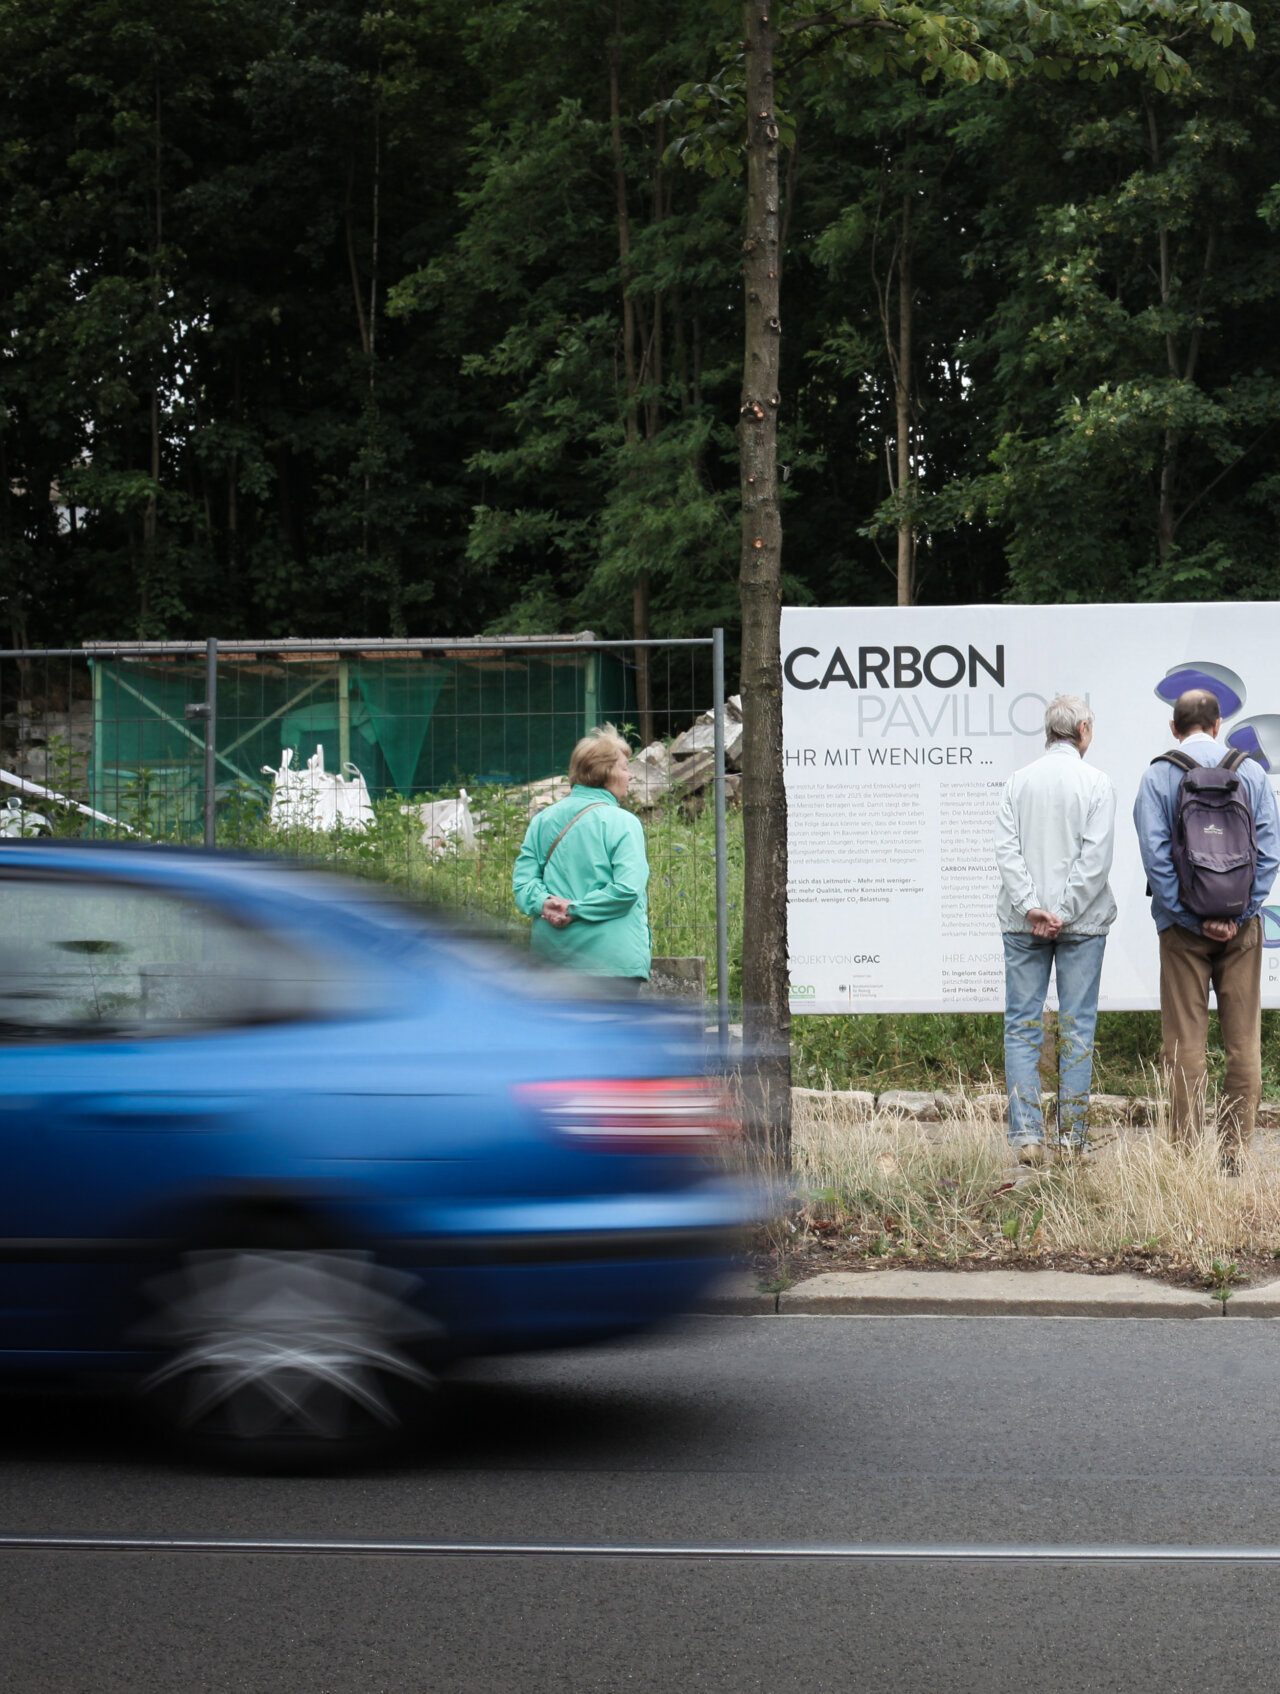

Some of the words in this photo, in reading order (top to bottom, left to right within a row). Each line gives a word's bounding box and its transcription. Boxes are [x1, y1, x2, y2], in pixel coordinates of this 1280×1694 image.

[784, 644, 1005, 690] CARBON
[857, 691, 1090, 738] PAVILLO
[786, 749, 816, 766] HR
[824, 748, 861, 766] MIT
[867, 747, 973, 766] WENIGER
[790, 955, 827, 965] ROJEKT
[829, 955, 851, 964] VON
[854, 954, 880, 964] GPAC
[942, 953, 967, 963] IHRE
[968, 953, 1005, 963] ANSPRE
[952, 970, 976, 978] Ingelore
